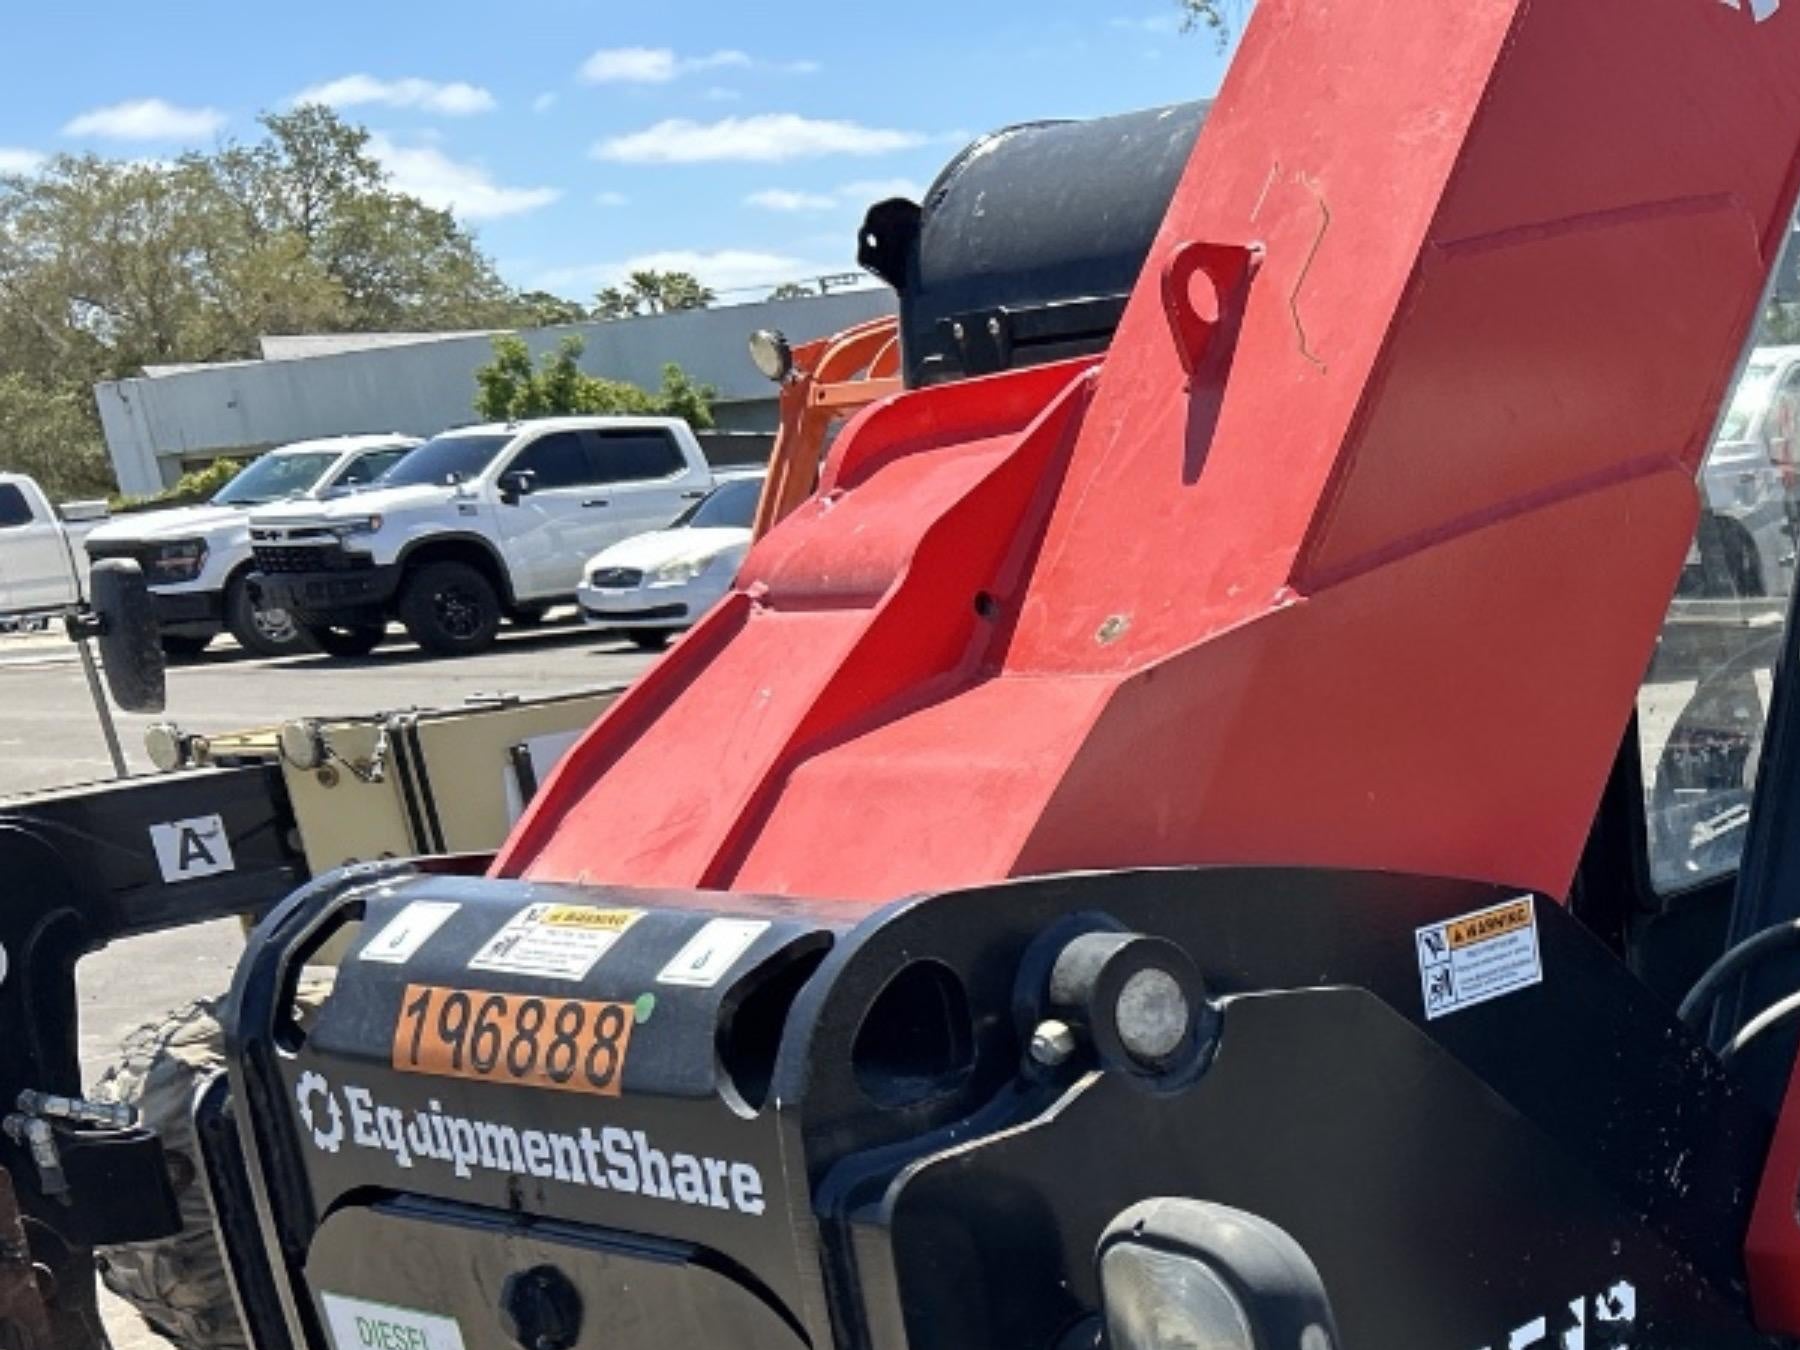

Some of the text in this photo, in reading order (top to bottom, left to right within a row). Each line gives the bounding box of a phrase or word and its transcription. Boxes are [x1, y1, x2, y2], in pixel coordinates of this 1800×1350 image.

[180, 827, 216, 870] A
[406, 988, 626, 1087] 196888
[344, 1085, 766, 1216] EquipmentShare
